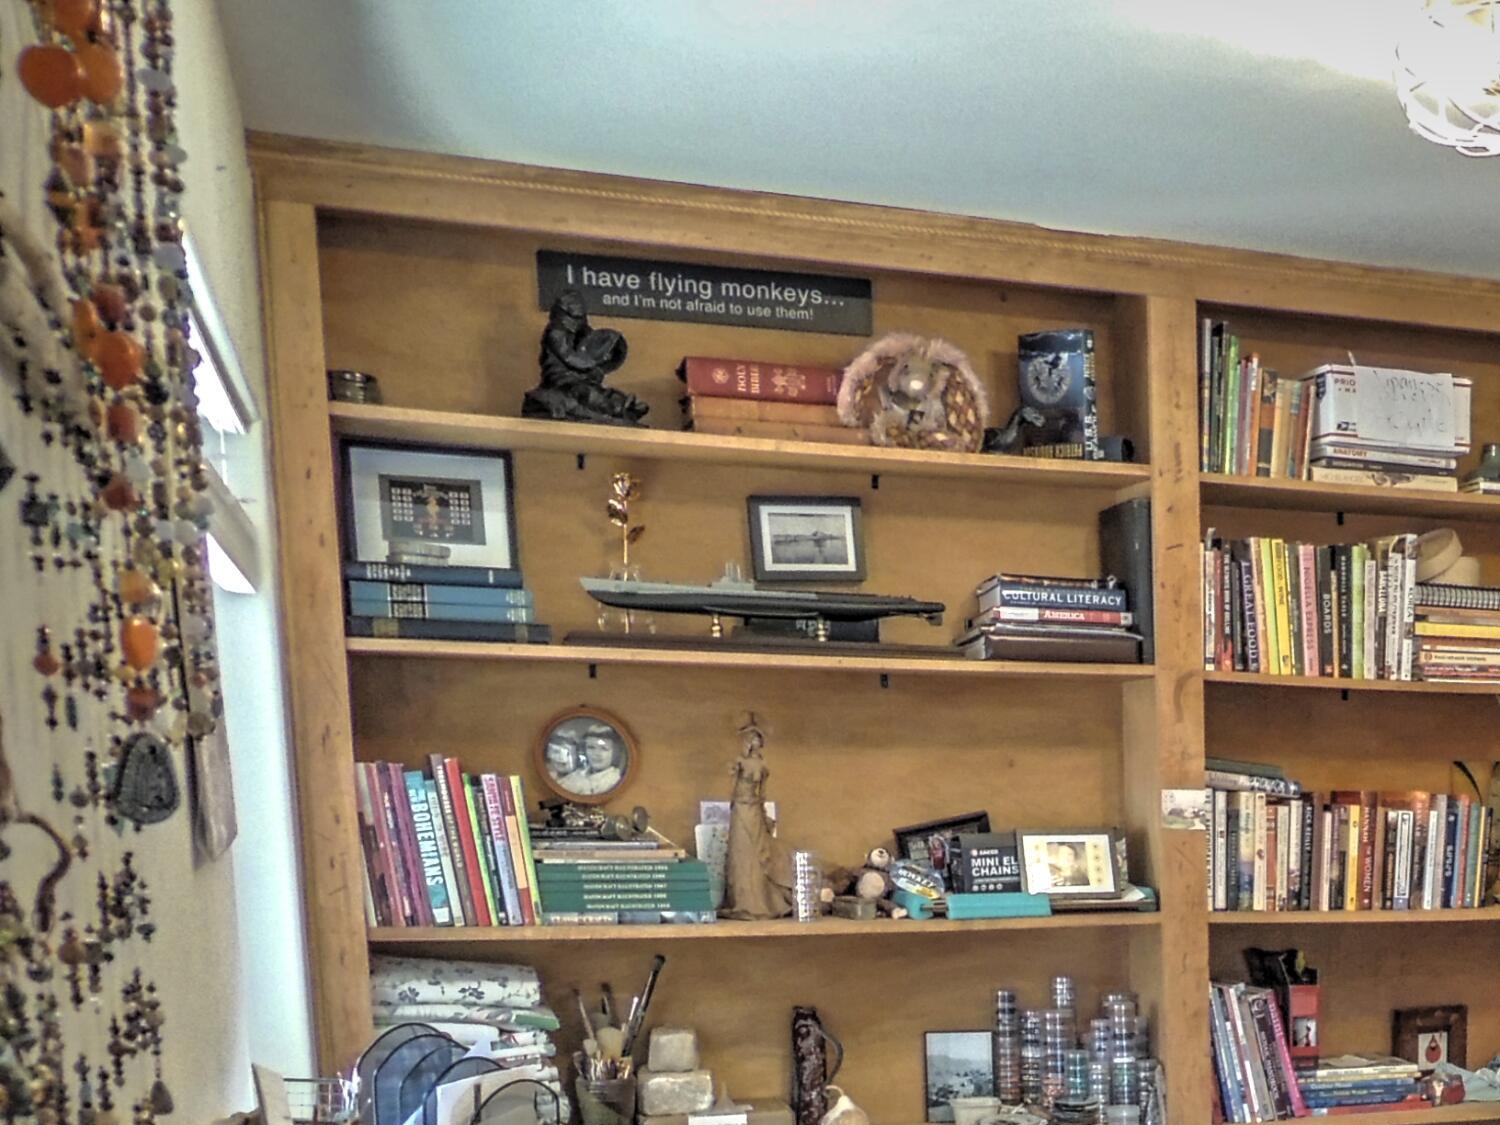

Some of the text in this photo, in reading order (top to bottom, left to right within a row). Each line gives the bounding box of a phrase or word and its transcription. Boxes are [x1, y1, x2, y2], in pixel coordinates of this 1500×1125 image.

[566, 264, 845, 307] I have flying monkeys...
[602, 292, 815, 321] and I'm not afraid to use them!
[1002, 590, 1122, 606] CULTURAL LITERACY
[1243, 574, 1254, 616] GREAT
[1303, 566, 1314, 650] NIGELLA EXPRESS
[1043, 610, 1086, 621] AMERICA
[1323, 593, 1332, 634] BOARDS
[1247, 621, 1257, 659] FOOD
[413, 803, 443, 886] BOHEMIANS
[970, 856, 999, 867] MINI
[972, 866, 1019, 877] CHAINS
[1363, 857, 1372, 892] WOMEN
